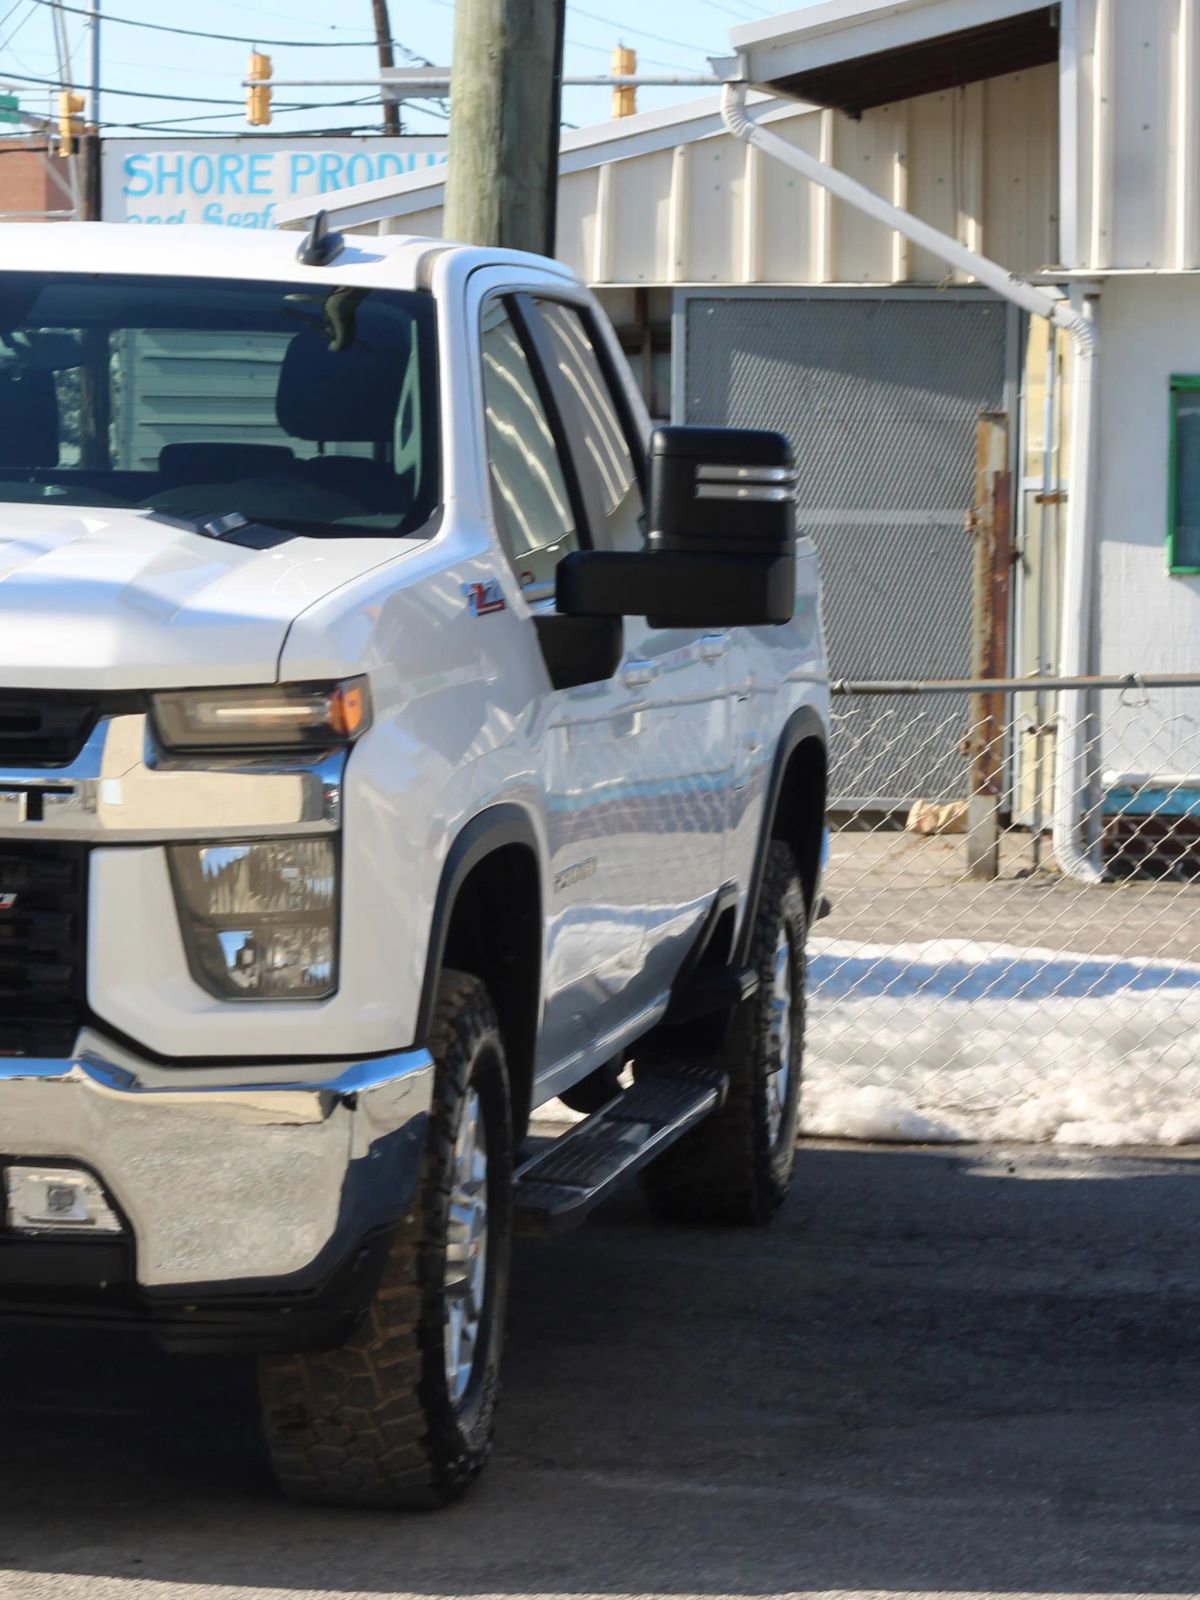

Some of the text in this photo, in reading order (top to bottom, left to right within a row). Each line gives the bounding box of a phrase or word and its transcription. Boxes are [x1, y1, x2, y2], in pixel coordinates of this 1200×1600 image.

[122, 153, 449, 196] SHORE PROD
[203, 202, 279, 230] Seaf
